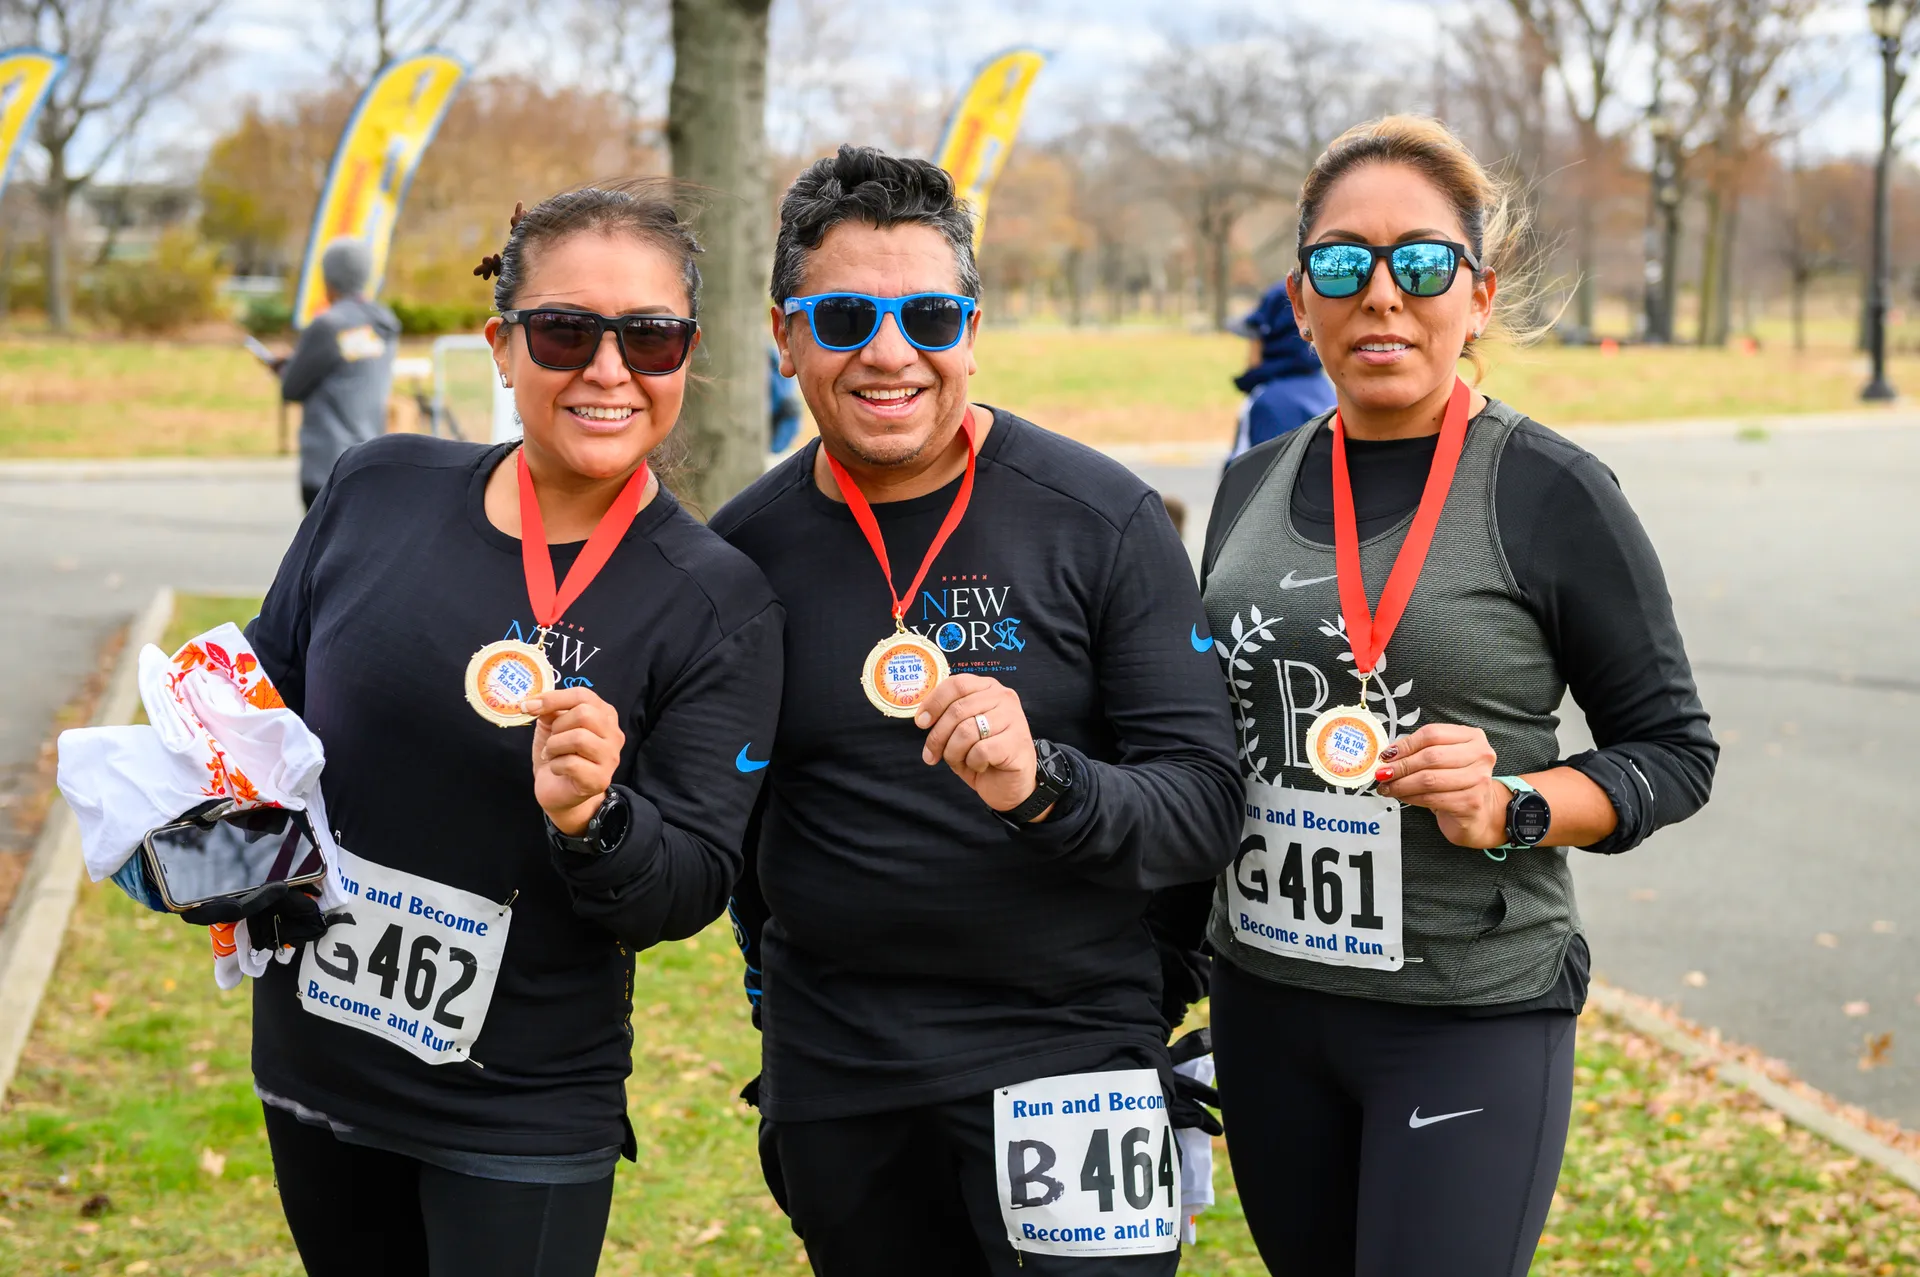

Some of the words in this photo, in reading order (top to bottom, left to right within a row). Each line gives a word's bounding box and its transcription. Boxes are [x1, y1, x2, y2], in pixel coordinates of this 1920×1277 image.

[922, 586, 1011, 621] NEW
[499, 664, 510, 676] 5k
[516, 678, 528, 692] 10k
[888, 666, 898, 674] 5k
[900, 665, 906, 673] &
[908, 664, 922, 672] 10k
[893, 674, 919, 682] Races
[498, 674, 520, 695] Races
[1333, 732, 1343, 742] 5k
[1344, 736, 1350, 744] &
[1352, 740, 1365, 751] 10k
[1334, 740, 1358, 756] Races
[1245, 803, 1261, 821] un
[1266, 808, 1296, 827] and
[1303, 810, 1381, 836] Become
[1233, 833, 1269, 905] G
[1278, 841, 1384, 931] 461
[338, 866, 360, 896] un
[366, 886, 402, 910] and
[408, 896, 489, 937] Become
[1239, 912, 1299, 945] Become
[1304, 932, 1338, 952] and
[1344, 935, 1384, 956] Run
[314, 912, 359, 986] G
[366, 922, 478, 1030] 462
[307, 979, 382, 1020] Become
[386, 1012, 419, 1038] and
[421, 1025, 456, 1052] Run
[1013, 1100, 1054, 1118] Run
[1062, 1094, 1100, 1114] and
[1108, 1092, 1165, 1112] Becom
[1007, 1139, 1065, 1210] B
[1080, 1125, 1174, 1213] 464
[1022, 1222, 1106, 1242] Become
[1114, 1218, 1150, 1238] and
